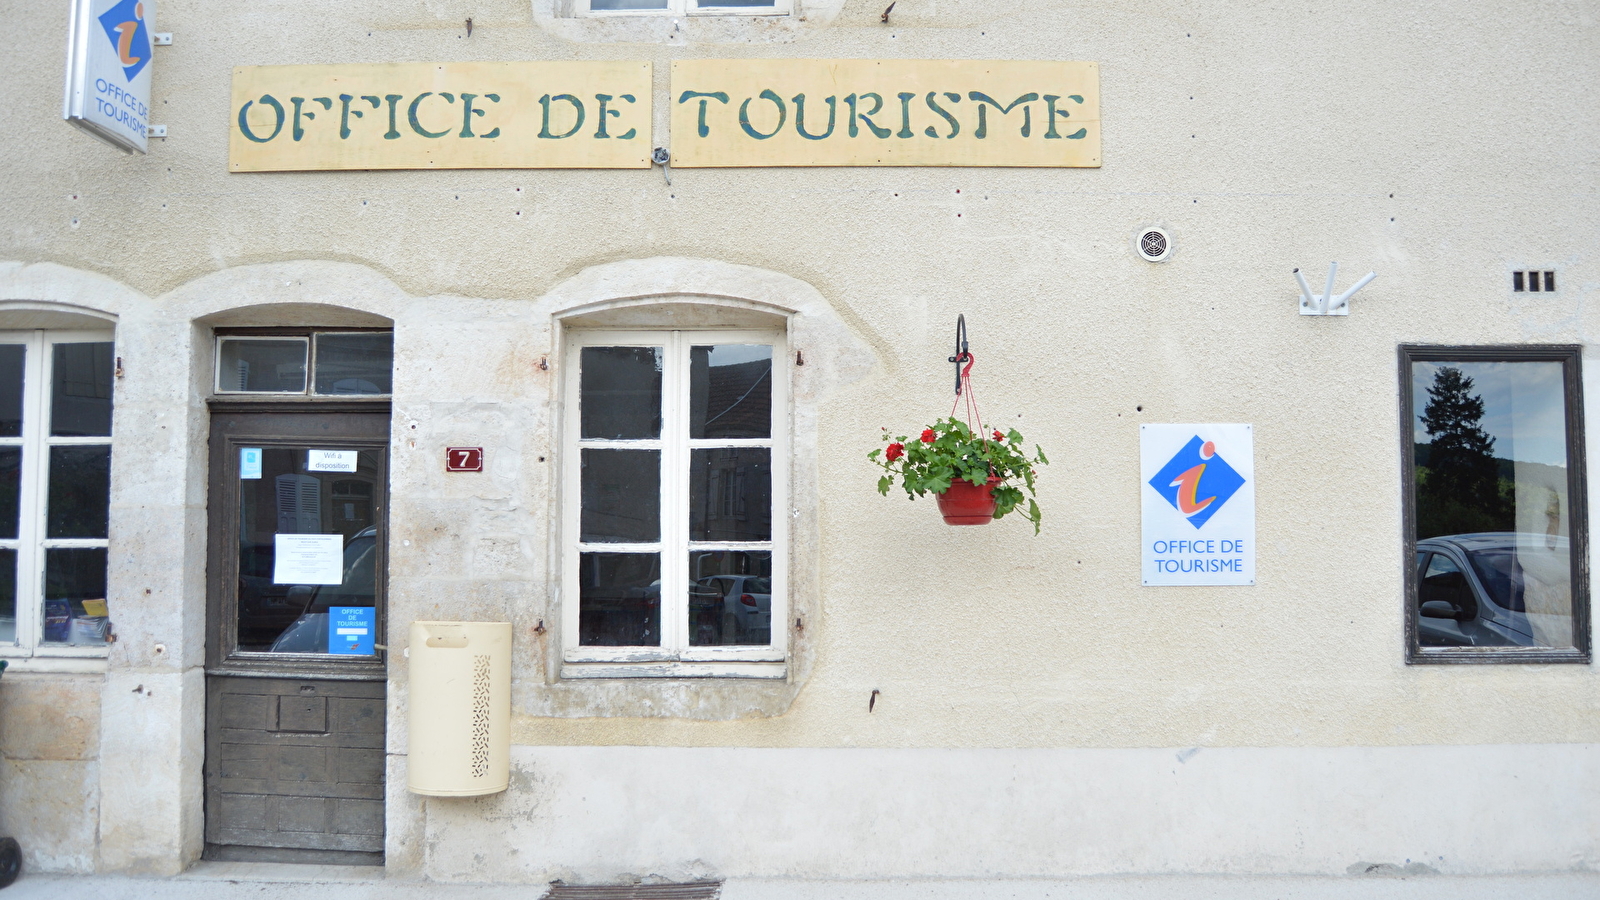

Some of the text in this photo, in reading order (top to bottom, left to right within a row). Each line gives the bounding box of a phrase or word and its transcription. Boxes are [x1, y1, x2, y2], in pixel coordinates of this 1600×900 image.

[95, 78, 148, 121] OFFICE DE
[95, 97, 147, 139] TOURISME
[237, 88, 1088, 143] OFFICE DE TOURISME
[458, 451, 470, 467] 7
[1153, 539, 1244, 554] OFFICE DE
[1154, 558, 1243, 573] TOURISME
